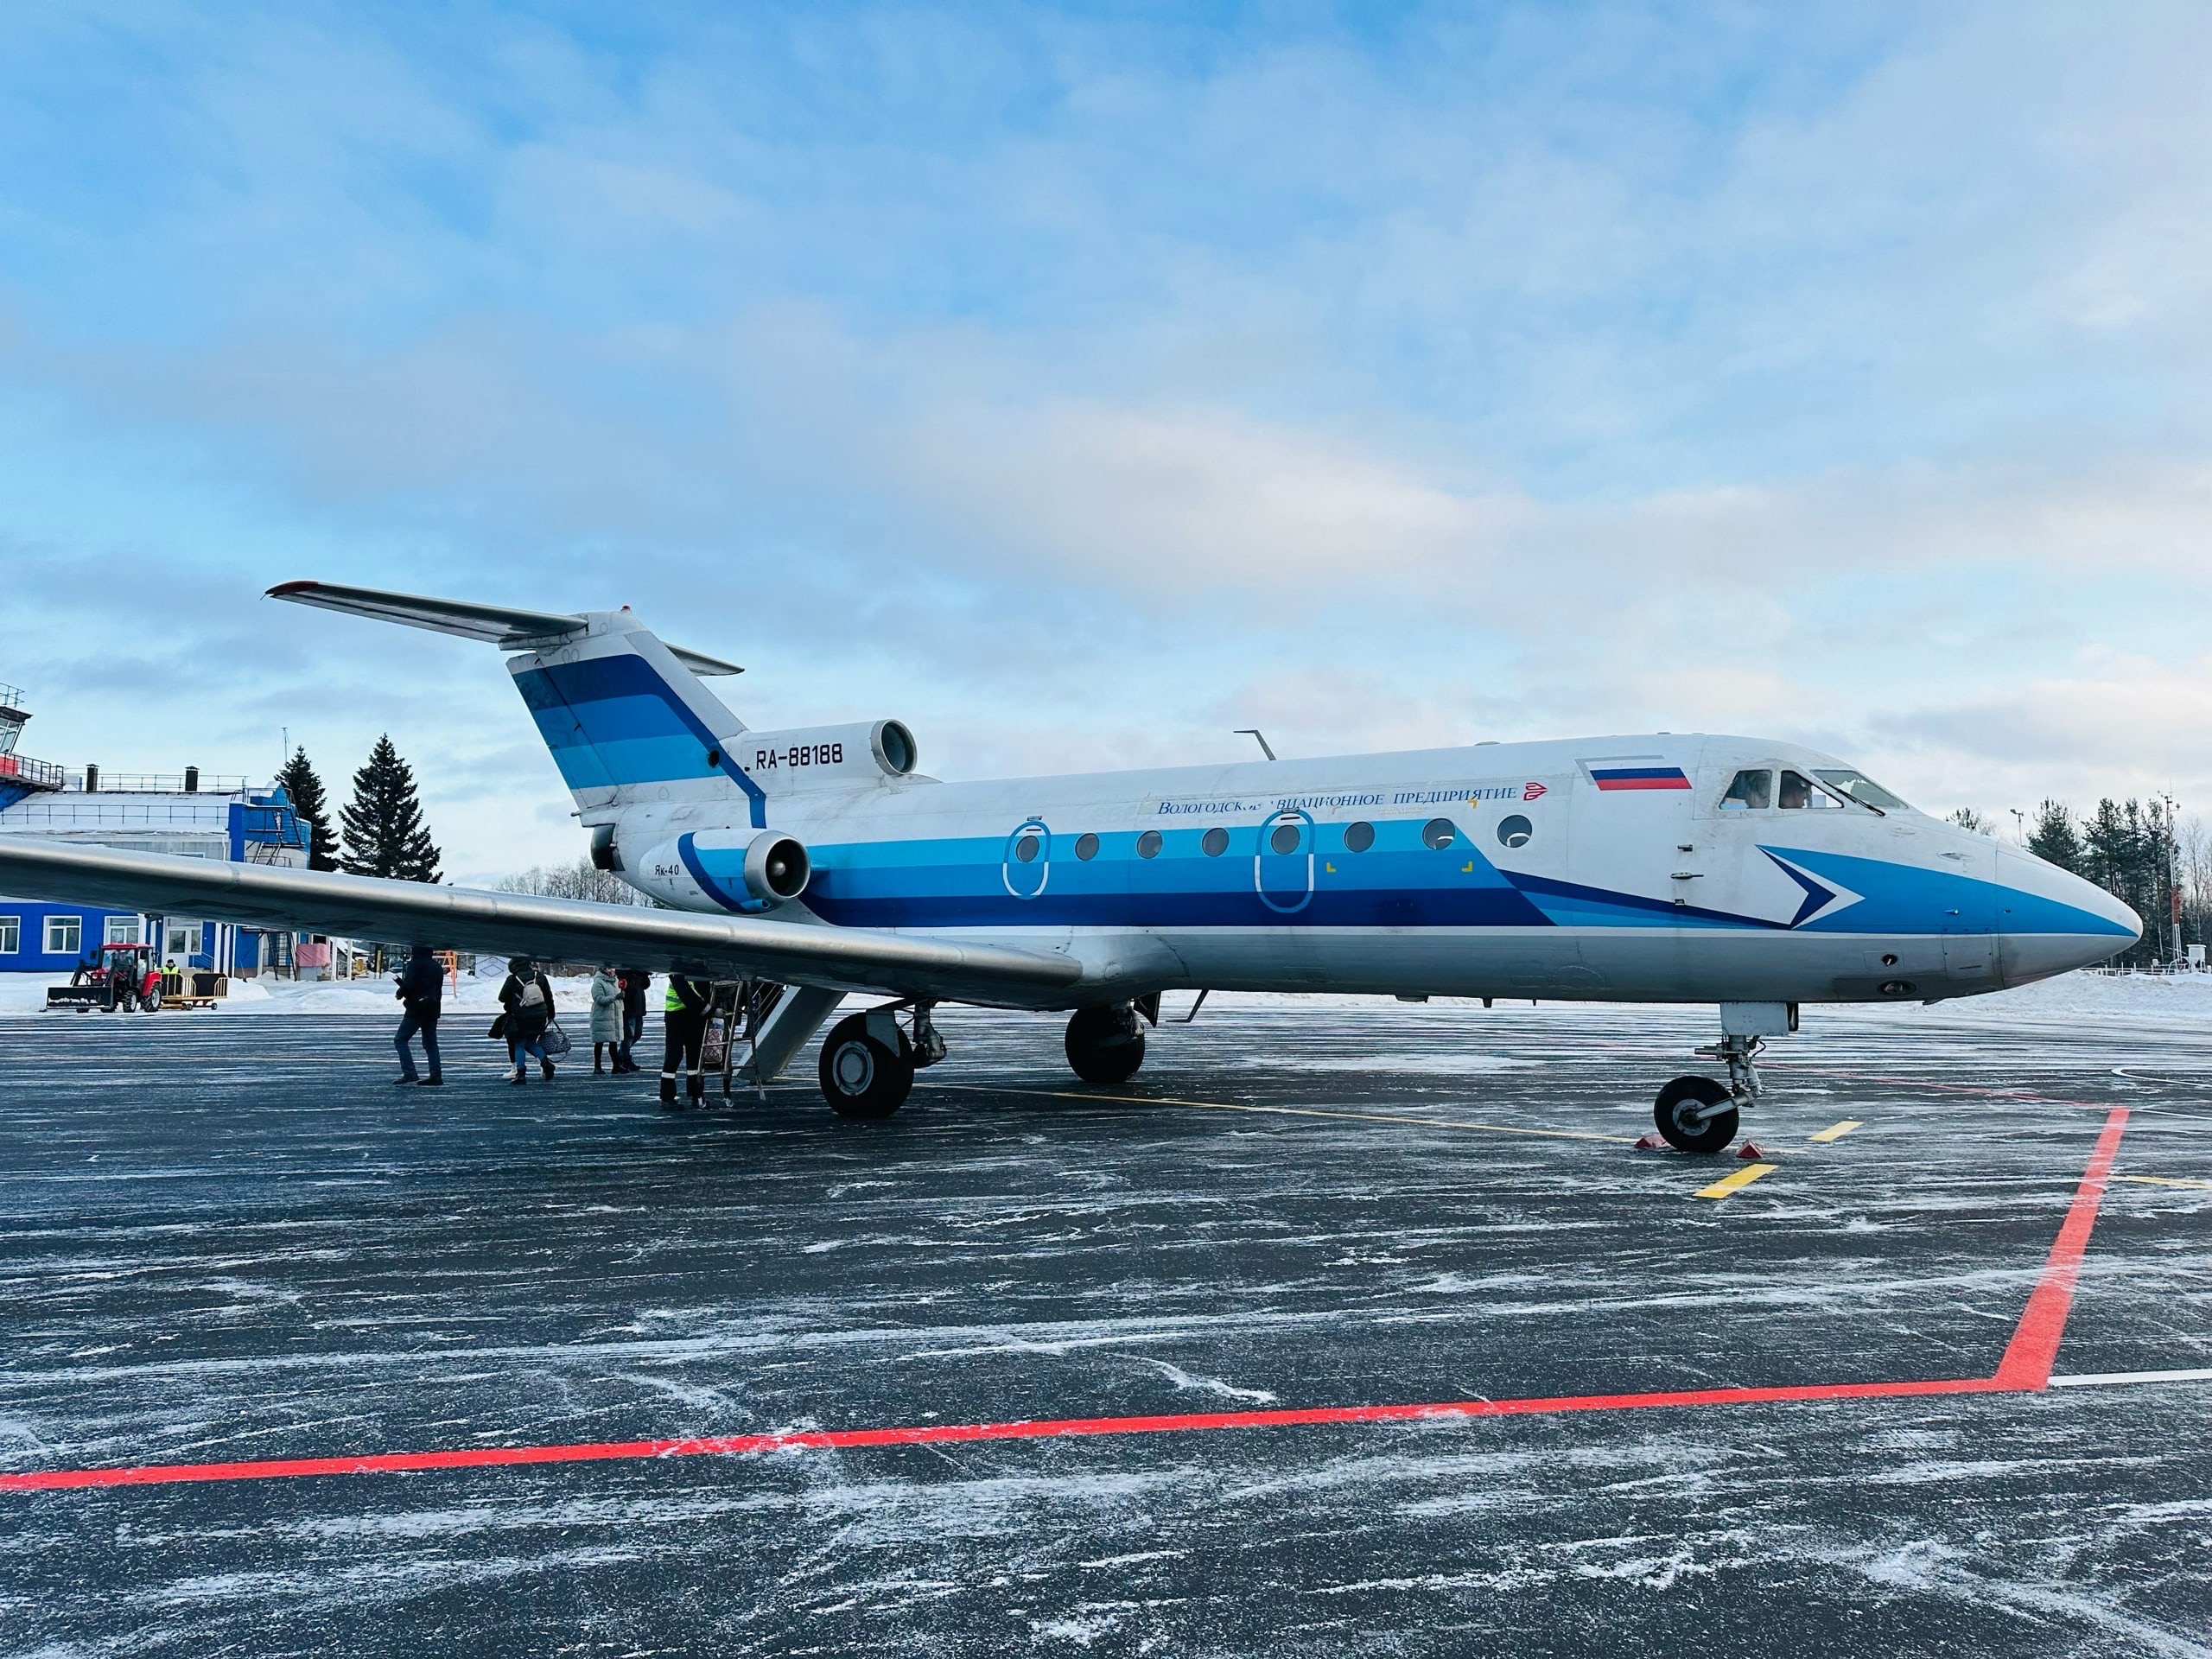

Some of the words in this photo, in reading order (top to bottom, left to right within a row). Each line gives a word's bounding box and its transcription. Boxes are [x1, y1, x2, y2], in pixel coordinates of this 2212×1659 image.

[756, 743, 843, 770] RA-88188
[1158, 801, 1262, 815] ВОЛОГОДСК
[1270, 793, 1384, 810] ВИАЦИОННОЕ
[1394, 787, 1517, 804] ПРЕДПРИЯТИЕ
[655, 864, 679, 875] Як-40
